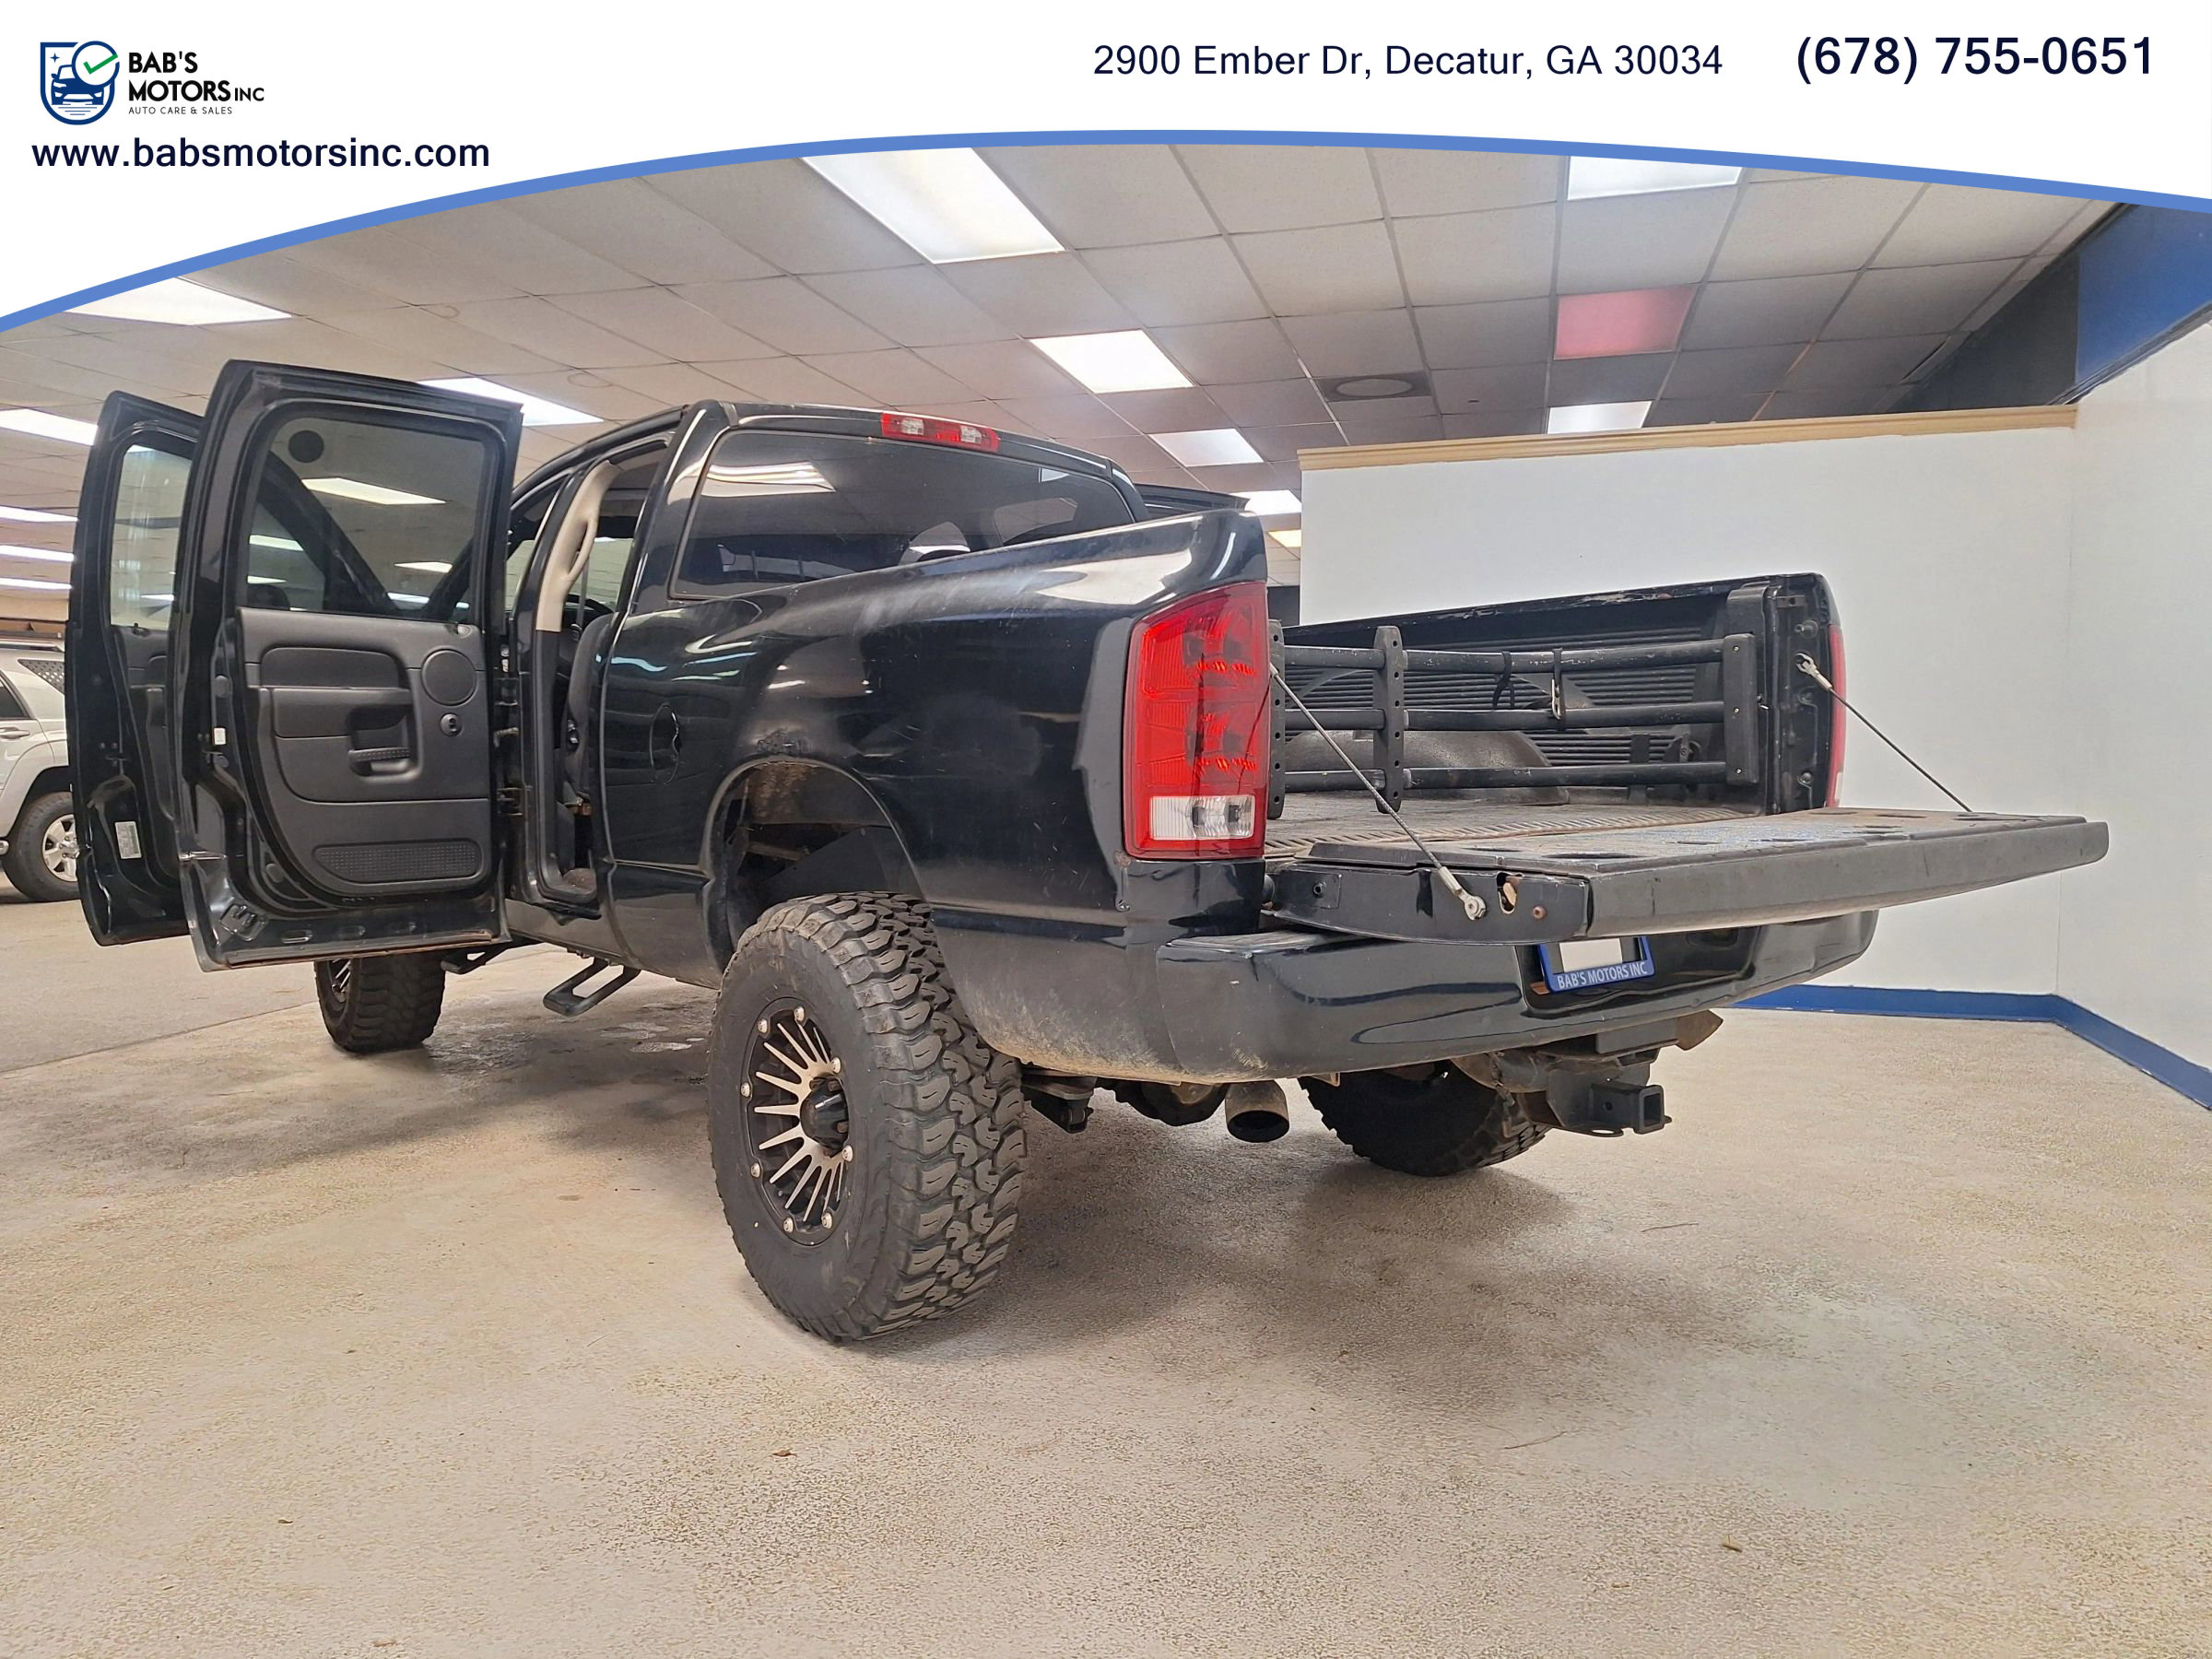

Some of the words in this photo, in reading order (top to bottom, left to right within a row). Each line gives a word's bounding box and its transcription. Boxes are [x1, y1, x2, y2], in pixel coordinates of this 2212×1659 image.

[1558, 971, 1587, 989] BAB'S
[1588, 965, 1629, 983] MOTORS
[1630, 961, 1648, 976] INC
